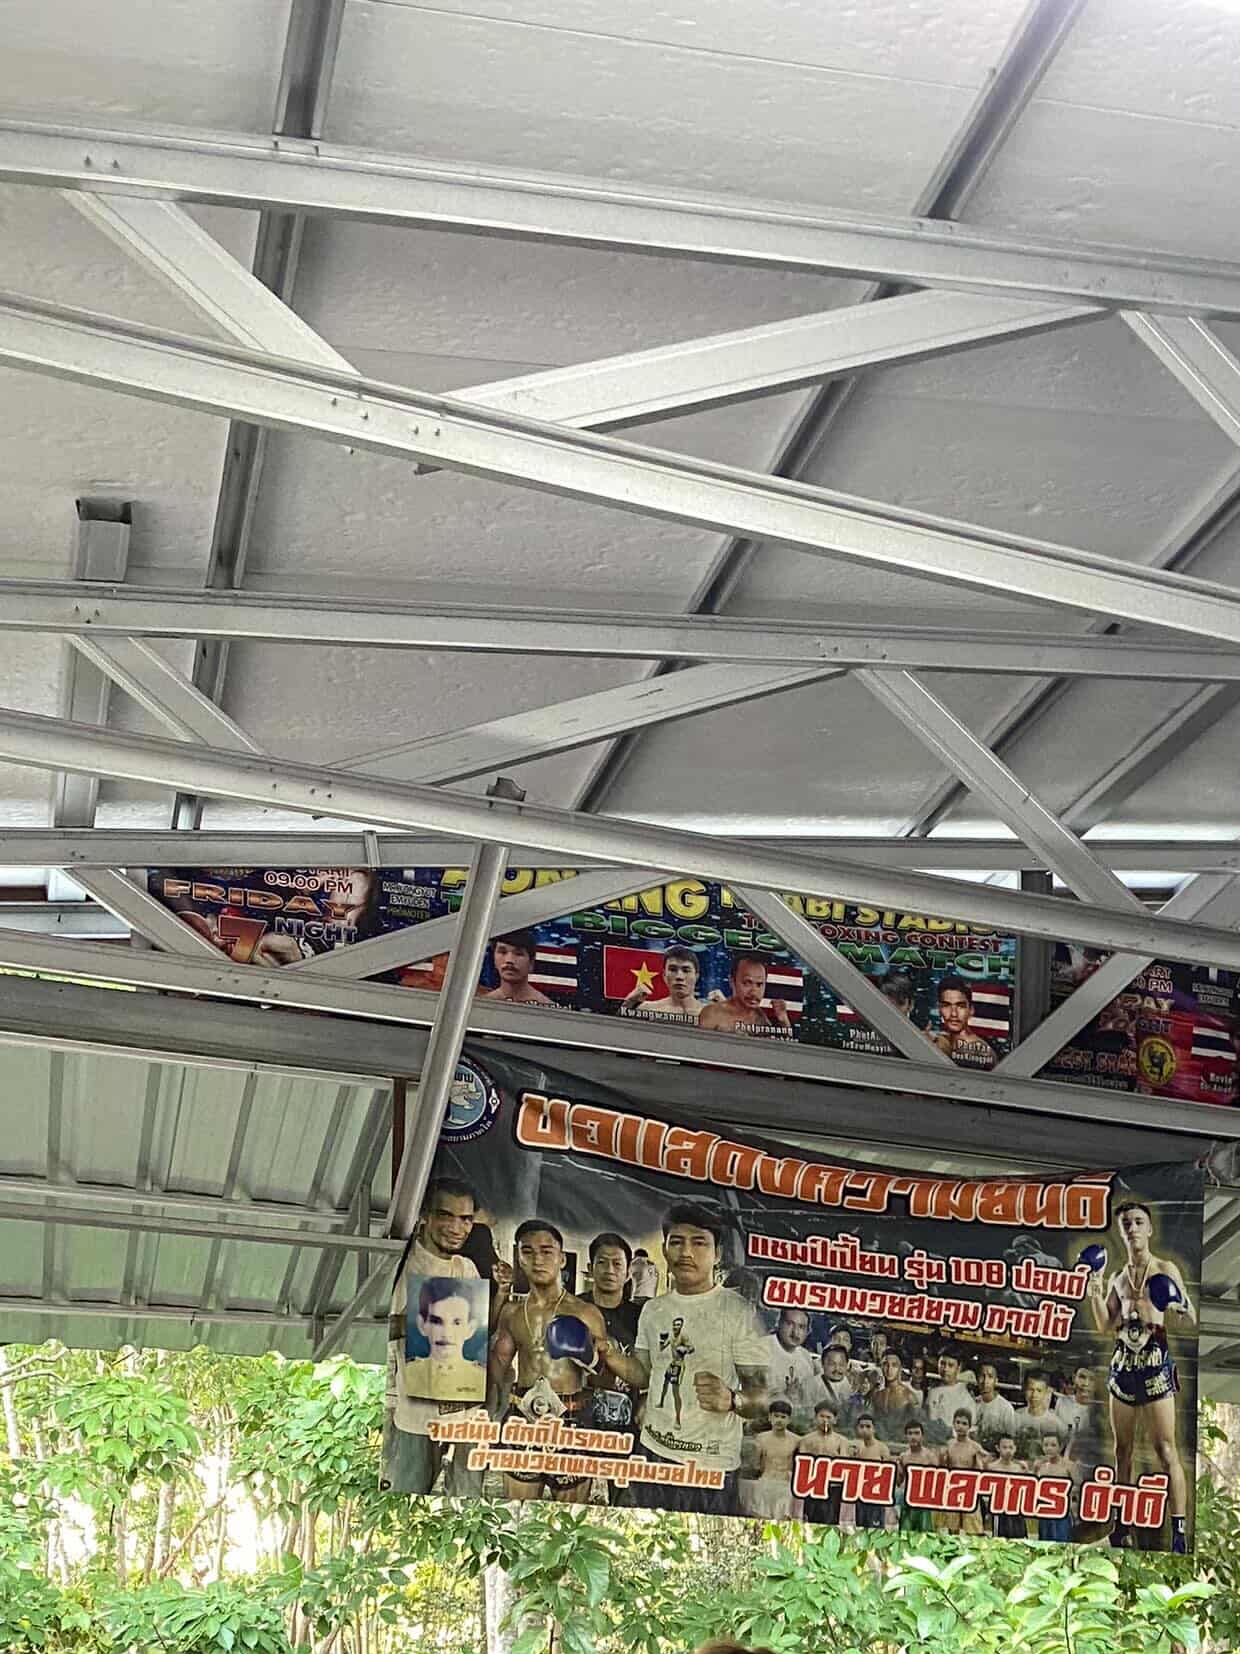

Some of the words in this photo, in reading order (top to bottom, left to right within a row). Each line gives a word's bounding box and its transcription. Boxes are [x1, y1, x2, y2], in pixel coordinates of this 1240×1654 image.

[163, 878, 356, 920] FRIDAY
[263, 871, 321, 891] 09.00
[324, 877, 354, 894] PM
[217, 913, 267, 963] 7
[274, 916, 359, 943] NIGHT
[570, 911, 785, 951] BIGGES
[905, 930, 1003, 952] CONTEST
[837, 943, 1016, 976] MATCH
[748, 1232, 898, 1278] แชมป์เปี้ยน
[904, 1250, 945, 1290] รุ่น
[948, 1256, 1006, 1287] 108
[1012, 1261, 1092, 1300] ปอนด์
[764, 1277, 981, 1329] ชมรมมวยสยาม
[986, 1303, 1075, 1341] ภาคใต้
[427, 1409, 502, 1443] จงสนั่น
[792, 1455, 897, 1505] นาย
[906, 1464, 1071, 1519] พลากร
[1079, 1465, 1169, 1529] ดำดี
